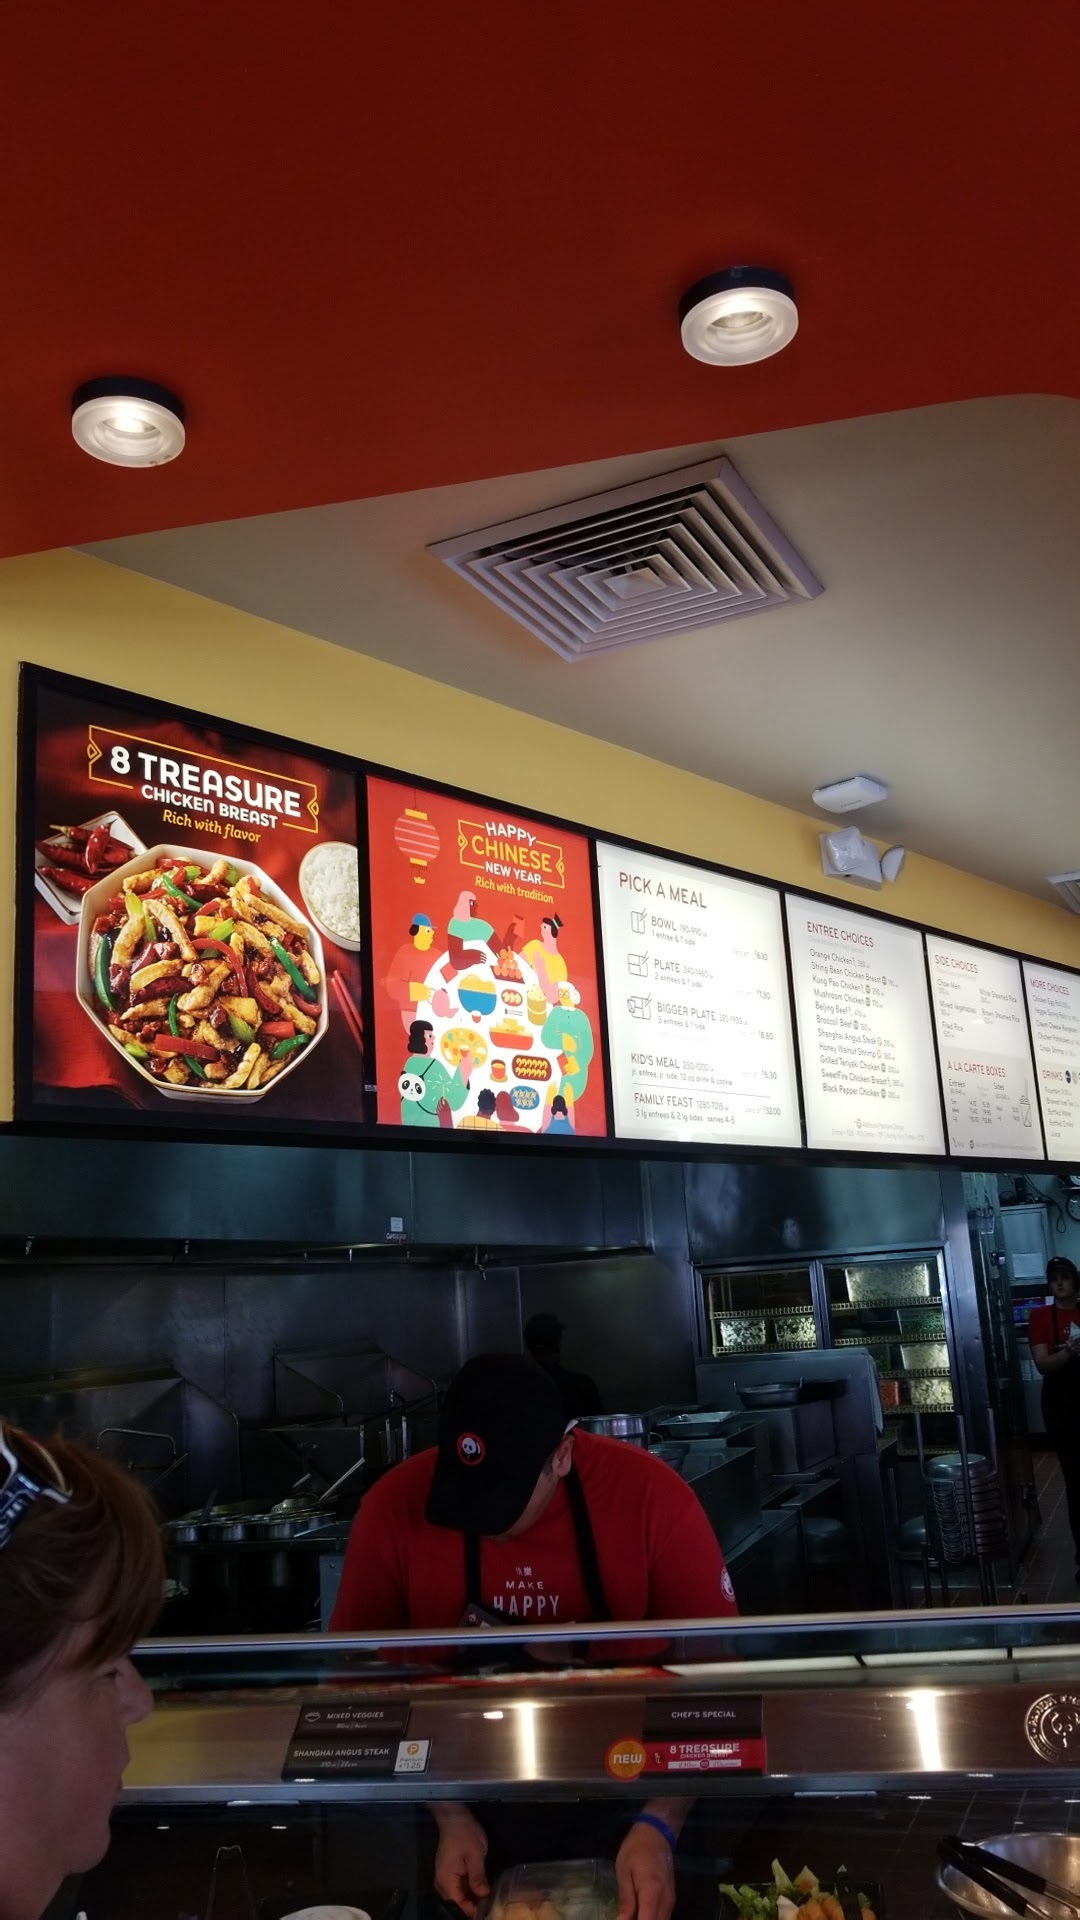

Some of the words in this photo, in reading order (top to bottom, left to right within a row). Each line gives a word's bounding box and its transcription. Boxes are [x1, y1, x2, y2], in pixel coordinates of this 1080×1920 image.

[110, 746, 131, 774] 8
[138, 752, 301, 818] TREASURE
[141, 784, 215, 815] CHICKEN
[219, 804, 278, 829] BREAST
[163, 809, 191, 828] Rich
[194, 819, 222, 835] with
[223, 824, 261, 843] flavor
[485, 822, 537, 847] HAPPY
[471, 835, 552, 873] CHINESE
[485, 861, 511, 877] NEW
[513, 868, 542, 885] YEAR
[475, 875, 495, 891] Rich
[496, 882, 516, 896] with
[517, 886, 554, 904] tradition
[619, 871, 652, 896] PICK
[656, 882, 666, 899] A
[669, 885, 707, 909] MEAL
[651, 916, 677, 931] BOWL
[656, 932, 673, 942] entree
[674, 934, 680, 943] &
[684, 938, 695, 946] side
[806, 921, 839, 939] ENTREE
[840, 930, 875, 948] CHOICES
[809, 948, 831, 961] Orange
[831, 953, 853, 965] Chicken
[935, 954, 949, 967] SIDE
[951, 958, 978, 974] CHOICES
[654, 958, 681, 973] PLATE
[811, 962, 829, 975] String
[829, 965, 843, 976] Bean
[844, 969, 865, 981] Chicken
[865, 974, 882, 984] Breast
[654, 971, 659, 980] 2
[660, 975, 681, 984] entrees
[812, 975, 828, 987] Kung
[828, 978, 840, 987] Pao
[840, 981, 861, 991] Chicken
[1030, 979, 1047, 990] MORE
[1047, 982, 1070, 996] CHOICES
[813, 988, 843, 1002] Mushroom
[844, 994, 865, 1005] Chicken
[657, 1002, 689, 1017] BIGGER
[690, 1008, 716, 1022] PLATE
[815, 1001, 835, 1014] Beijing
[835, 1004, 848, 1014] Beef
[657, 1016, 662, 1024] 3
[663, 1018, 684, 1029] entrees
[684, 1020, 690, 1028] &
[694, 1021, 706, 1030] side
[816, 1015, 839, 1027] Broccoli
[839, 1018, 853, 1028] Beef
[817, 1028, 843, 1040] Shanghai
[845, 1031, 862, 1043] Angus
[862, 1035, 877, 1045] Steak
[818, 1042, 837, 1054] Honey
[838, 1045, 857, 1055] Walnut
[857, 1048, 876, 1059] Shrimp
[630, 1053, 654, 1066] KID'S
[656, 1056, 680, 1069] MEAL
[820, 1055, 839, 1066] Grilled
[839, 1058, 859, 1069] Teriyaki
[860, 1061, 880, 1072] Chicken
[821, 1069, 848, 1081] SweetFire
[849, 1073, 871, 1084] Chicken
[871, 1075, 888, 1085] Breast
[947, 1061, 952, 1070] A
[954, 1062, 963, 1072] LA
[963, 1063, 985, 1076] CARTE
[985, 1066, 1006, 1078] BOXES
[680, 1073, 687, 1081] 12
[695, 1074, 710, 1083] drink
[822, 1083, 838, 1093] Black
[839, 1085, 858, 1096] Pepper
[859, 1087, 880, 1097] Chicken
[634, 1092, 665, 1106] FAMILY
[667, 1096, 694, 1108] FEAST
[635, 1108, 641, 1117] 3
[648, 1110, 670, 1120] entrees
[671, 1111, 676, 1119] &
[677, 1112, 682, 1120] 2
[688, 1113, 703, 1122] sides
[506, 1581, 544, 1590] MAKE
[494, 1595, 560, 1617] HAPPY
[327, 1712, 351, 1720] MIXED
[352, 1711, 385, 1719] VEGGIES
[671, 1711, 700, 1719] CHEF'S
[293, 1749, 334, 1757] SHANGHAI
[335, 1749, 362, 1757] ANGUS
[363, 1748, 390, 1756] STEAK
[669, 1745, 677, 1754] 8
[679, 1743, 740, 1754] TREASURE
[613, 1754, 643, 1764] NEW
